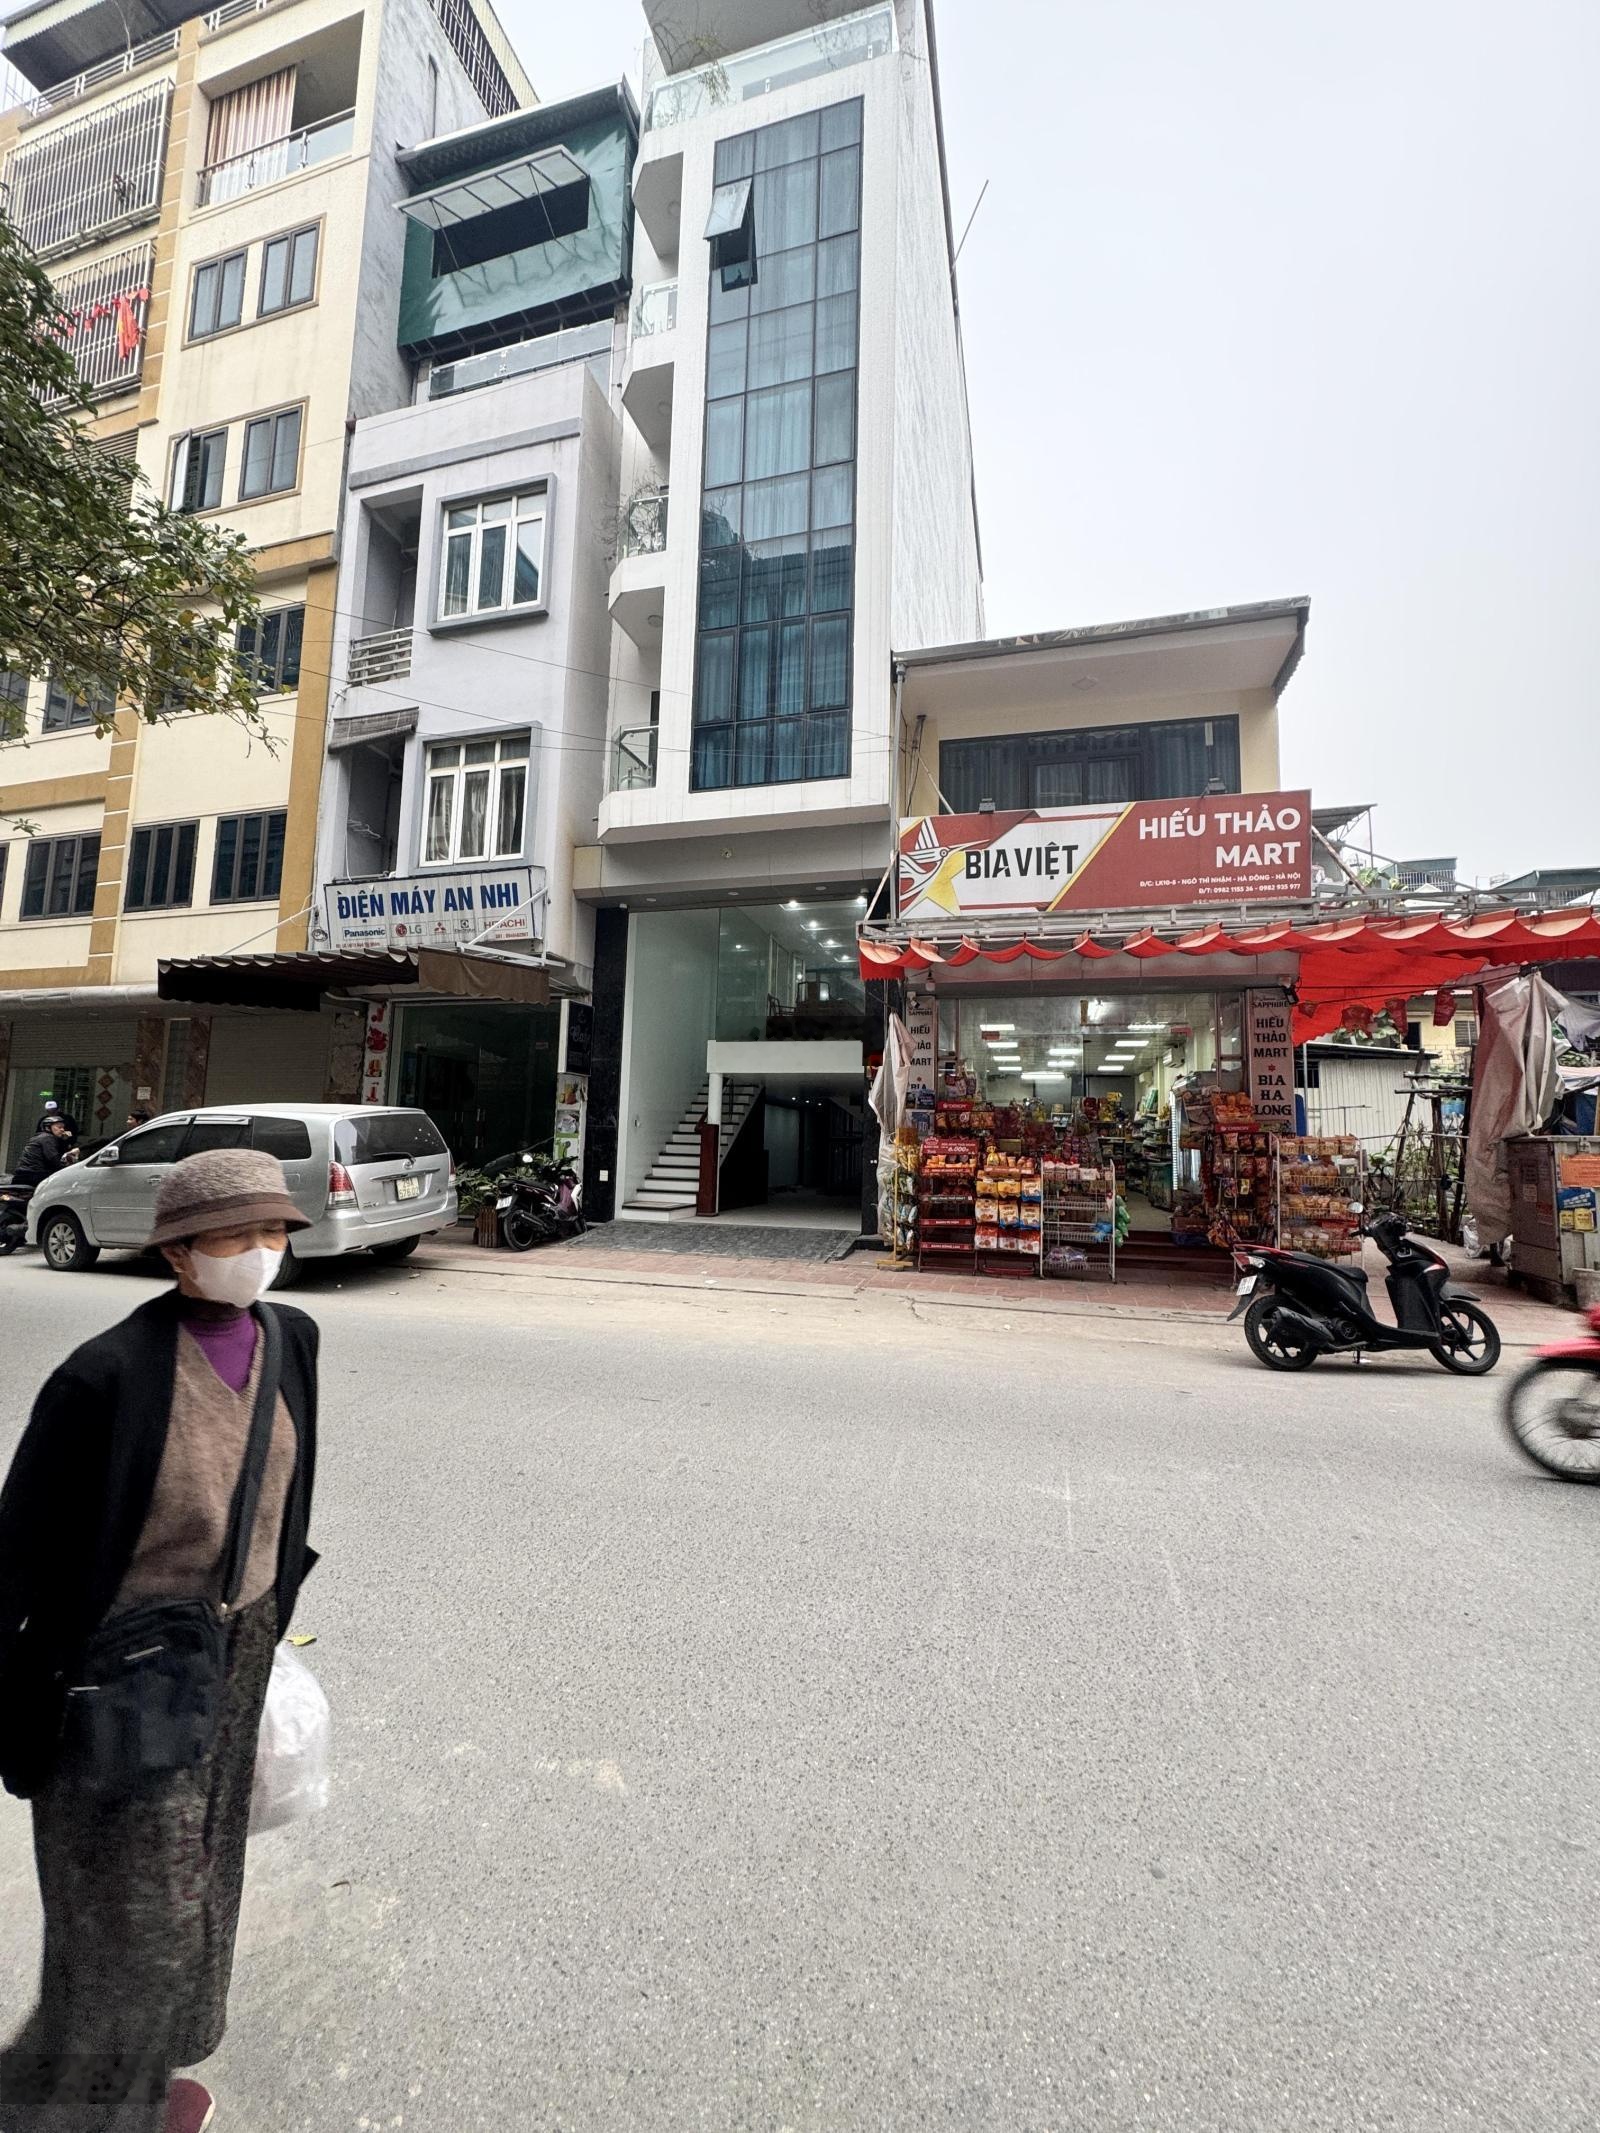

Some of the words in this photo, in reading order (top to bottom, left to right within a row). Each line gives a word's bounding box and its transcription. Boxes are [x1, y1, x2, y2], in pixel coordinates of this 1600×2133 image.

[1139, 807, 1206, 840] HIẾU
[1214, 803, 1301, 835] THẢO
[965, 848, 1011, 879] BIA
[1014, 841, 1079, 880] VIỆT
[1216, 841, 1301, 868] MART
[1237, 873, 1247, 882] HÀ
[1275, 871, 1286, 880] HÀ
[1287, 871, 1301, 881] NỘI
[337, 889, 385, 923] ĐIỆN
[390, 885, 436, 915] MÁY
[444, 886, 474, 912] AN
[480, 882, 519, 909] NHI
[344, 927, 386, 938] Panasonic
[409, 924, 422, 934] LG
[1256, 1015, 1284, 1028] HIẾU
[910, 1023, 930, 1035] HIẾU
[1253, 1030, 1287, 1043] THẢO
[1253, 1047, 1288, 1058] MART
[1258, 1075, 1286, 1086] BIA
[1254, 1104, 1292, 1116] LONG
